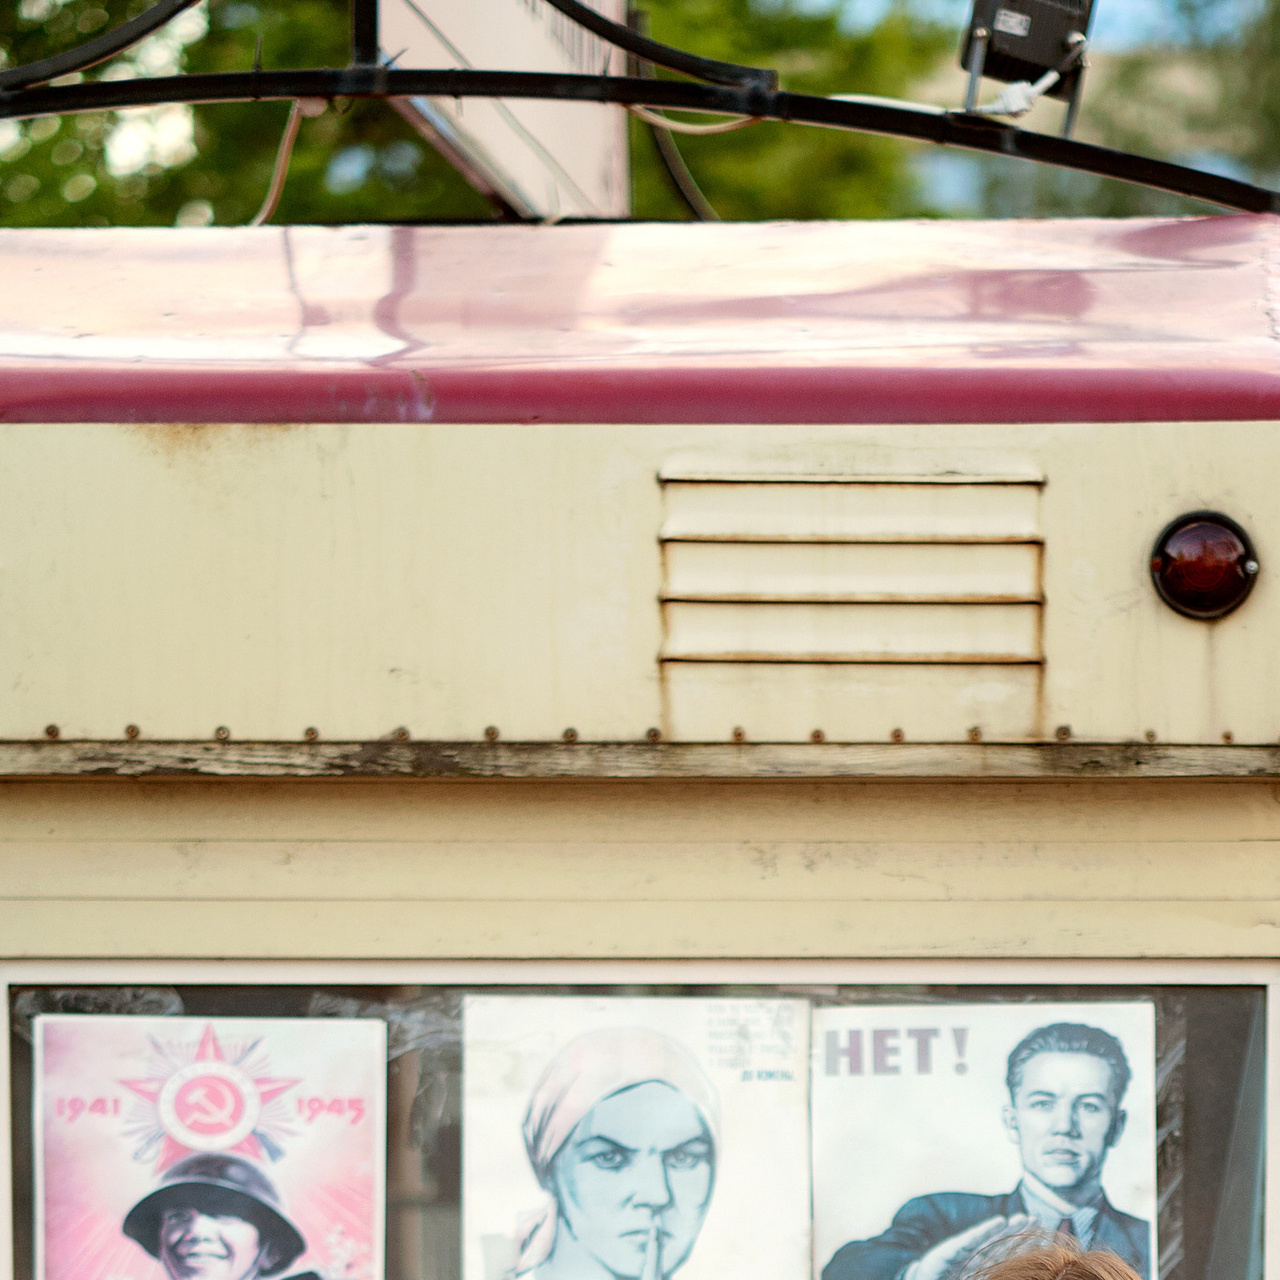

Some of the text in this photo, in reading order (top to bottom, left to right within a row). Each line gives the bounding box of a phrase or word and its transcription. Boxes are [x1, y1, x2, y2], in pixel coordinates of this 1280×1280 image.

[825, 1027, 969, 1076] НЕТ!
[55, 1097, 365, 1125] 1941 1945
